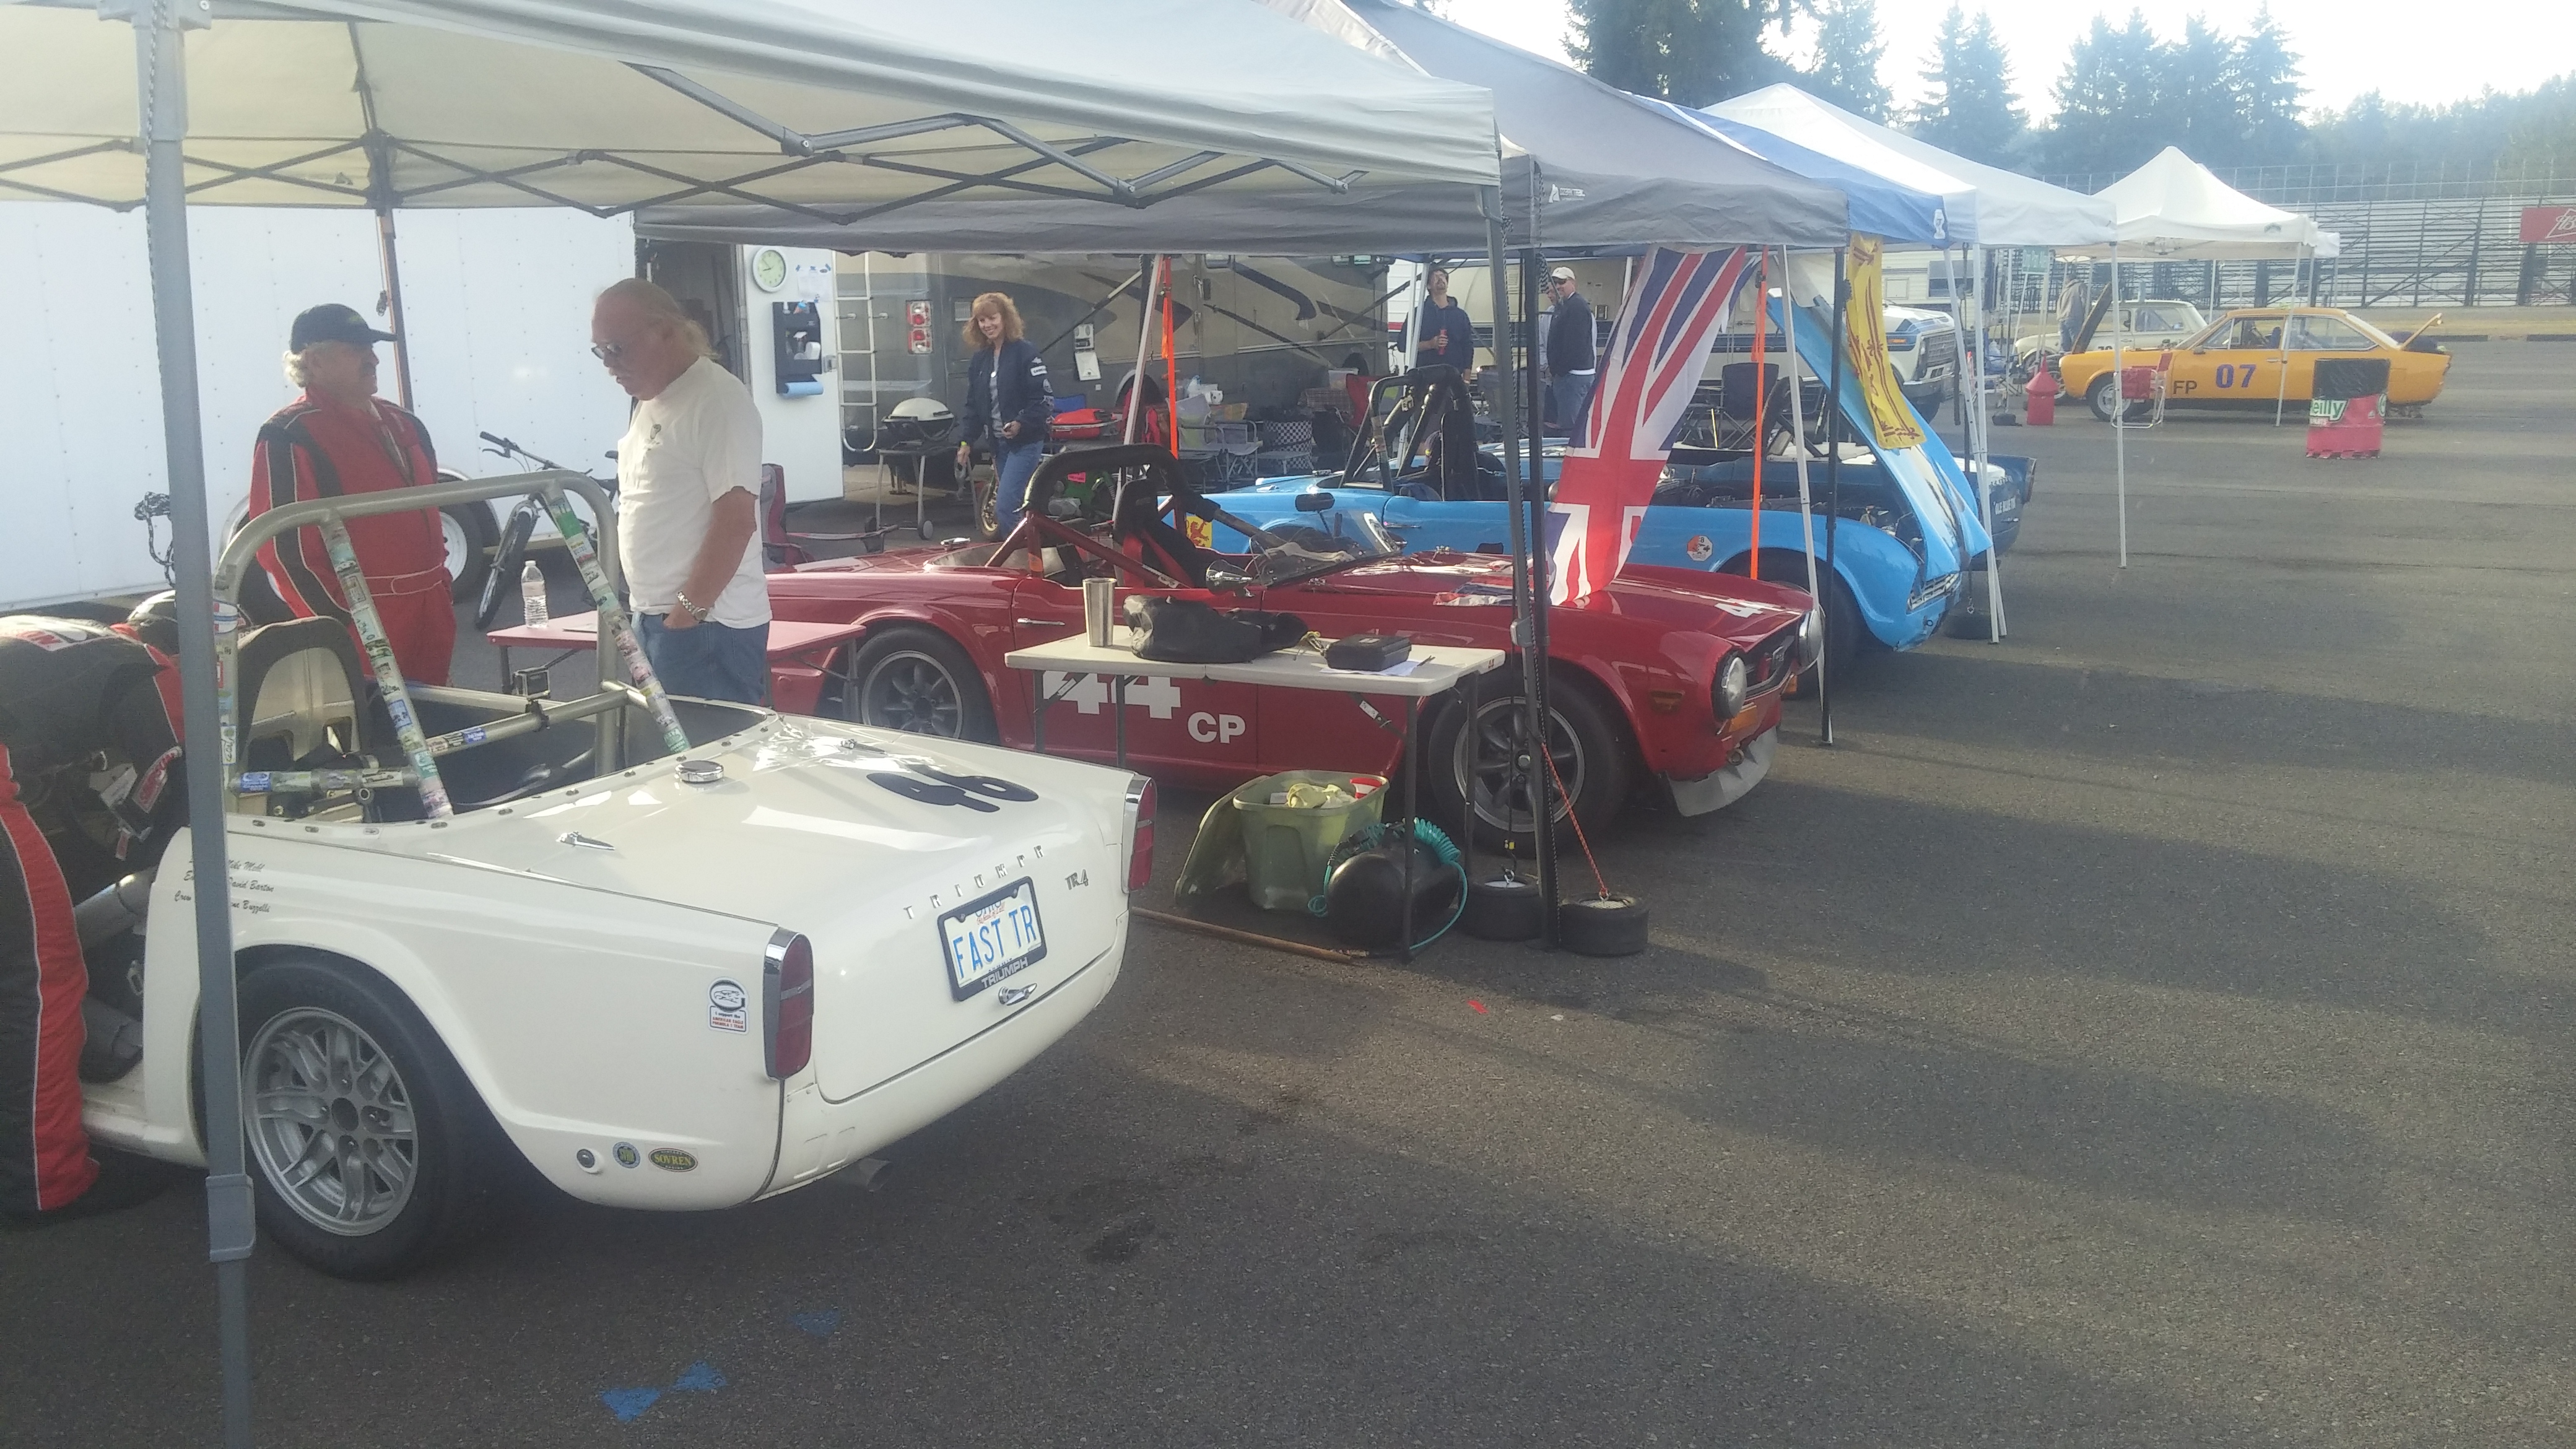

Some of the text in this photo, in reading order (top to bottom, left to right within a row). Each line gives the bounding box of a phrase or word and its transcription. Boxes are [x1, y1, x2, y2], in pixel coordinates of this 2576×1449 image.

[2173, 380, 2198, 394] FP
[2215, 363, 2256, 389] 07
[1187, 711, 1247, 744] CP
[903, 845, 1045, 920] TRIUMPH
[952, 918, 1005, 979] FAST
[1008, 905, 1037, 948] TR
[981, 956, 1029, 989] TRIUMPH
[654, 1154, 692, 1165] SOVREN
